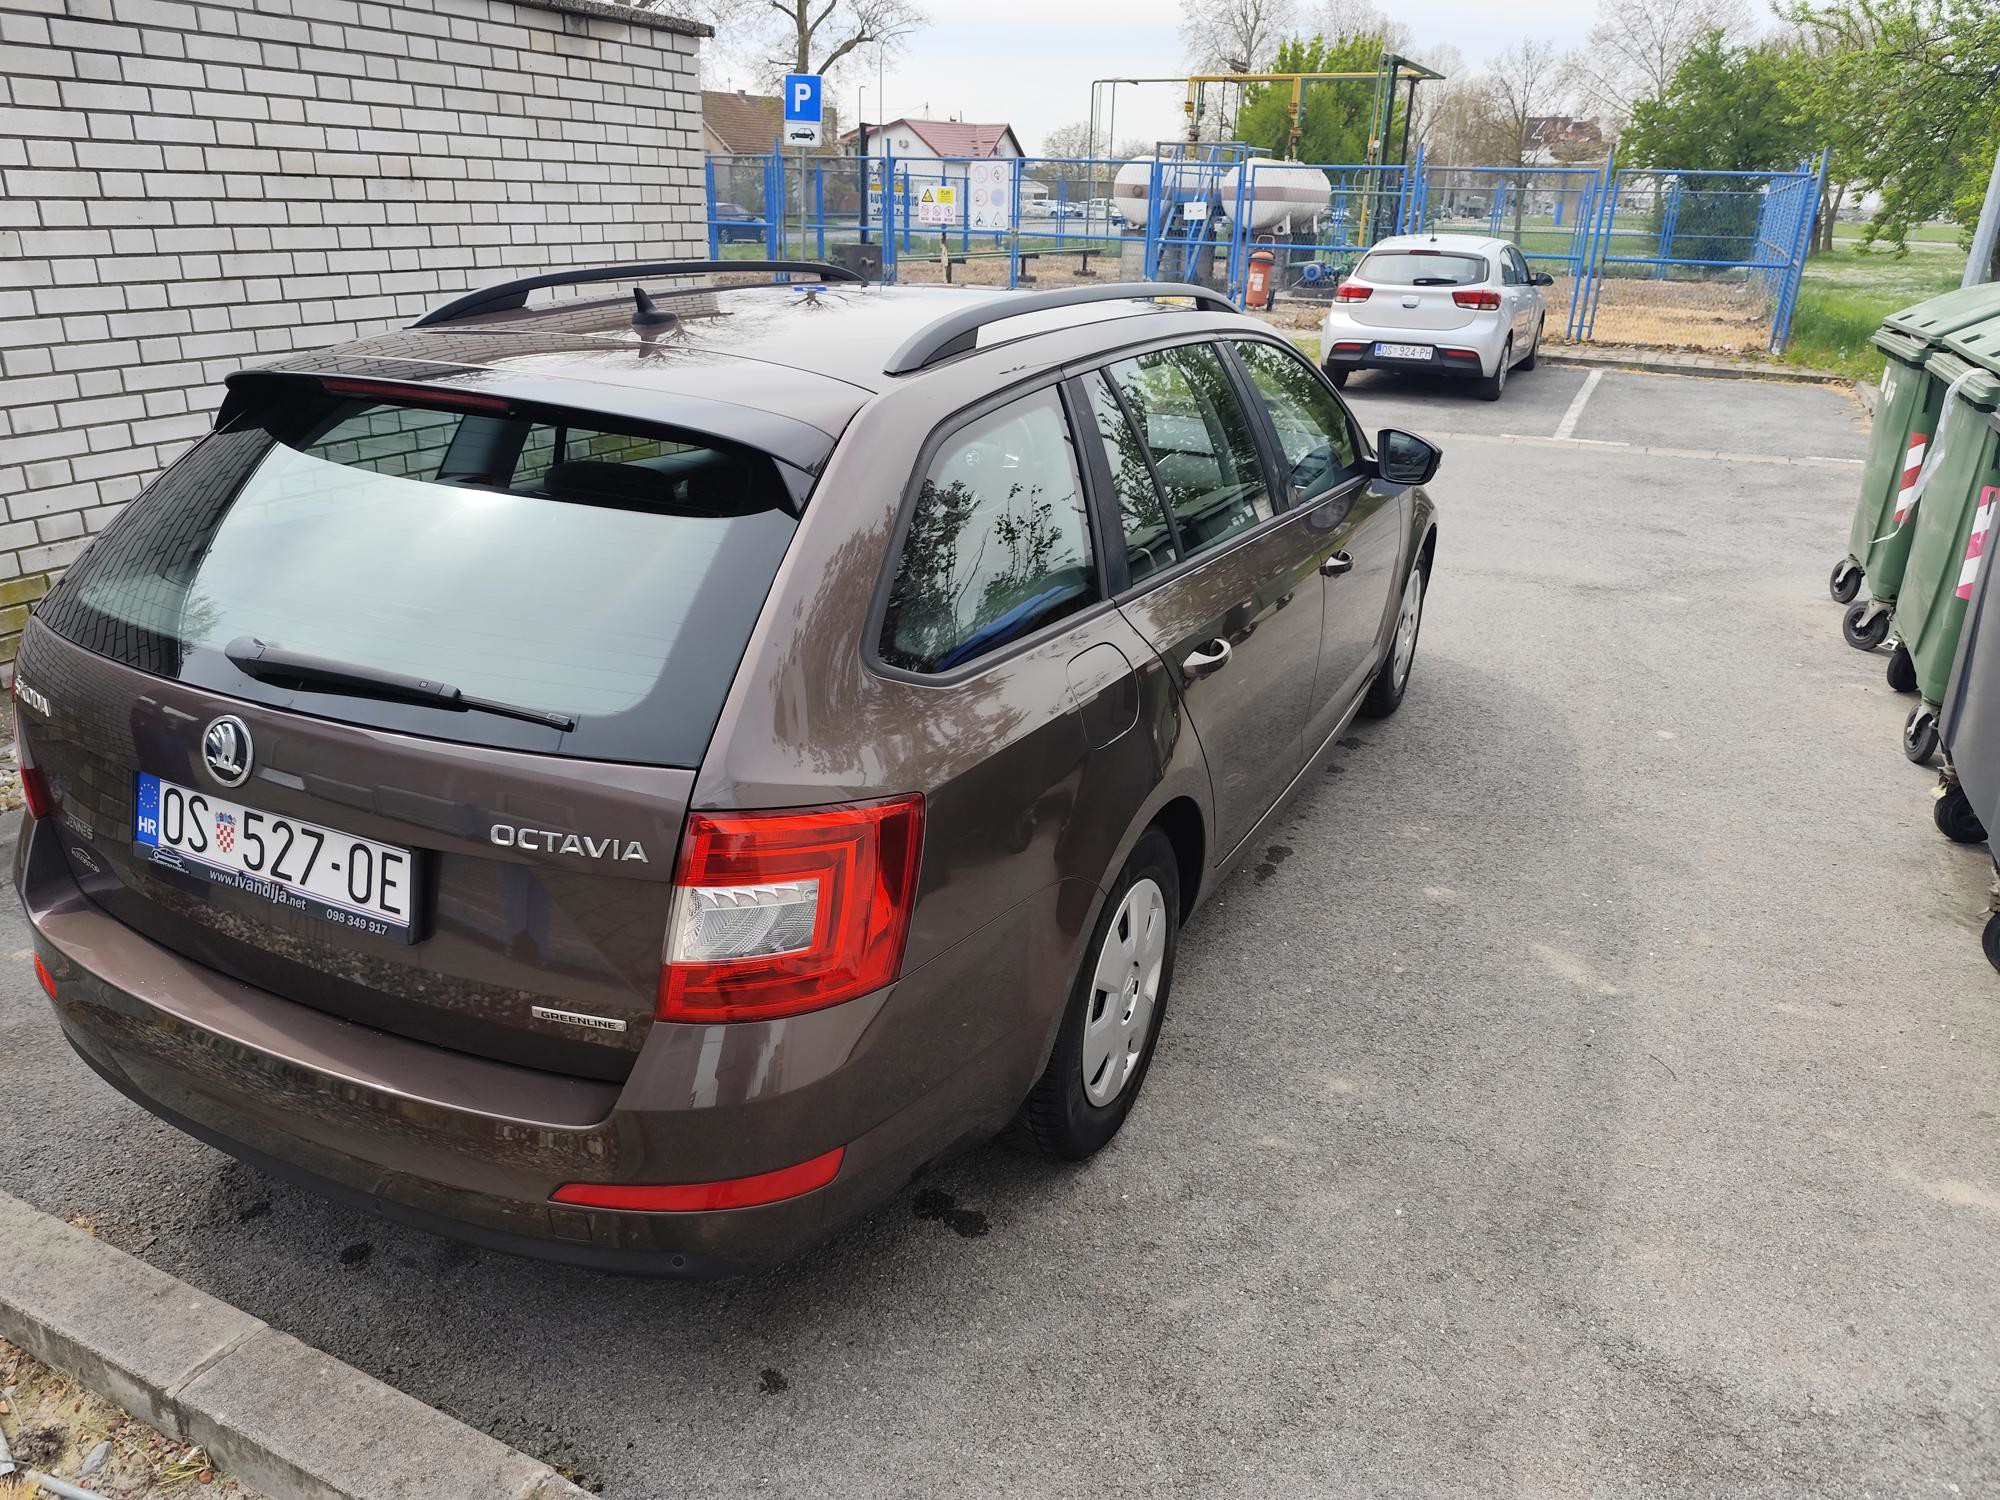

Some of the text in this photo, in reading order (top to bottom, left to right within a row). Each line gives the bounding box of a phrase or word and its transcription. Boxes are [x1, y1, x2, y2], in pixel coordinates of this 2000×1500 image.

[794, 83, 812, 113] P
[1382, 345, 1432, 359] OS 924-PH
[138, 815, 157, 836] HR
[163, 788, 403, 915] OS 527-OE
[490, 824, 649, 864] OCTAVIA
[326, 908, 388, 936] 098 349 917
[541, 1010, 617, 1030] GREENLINE
